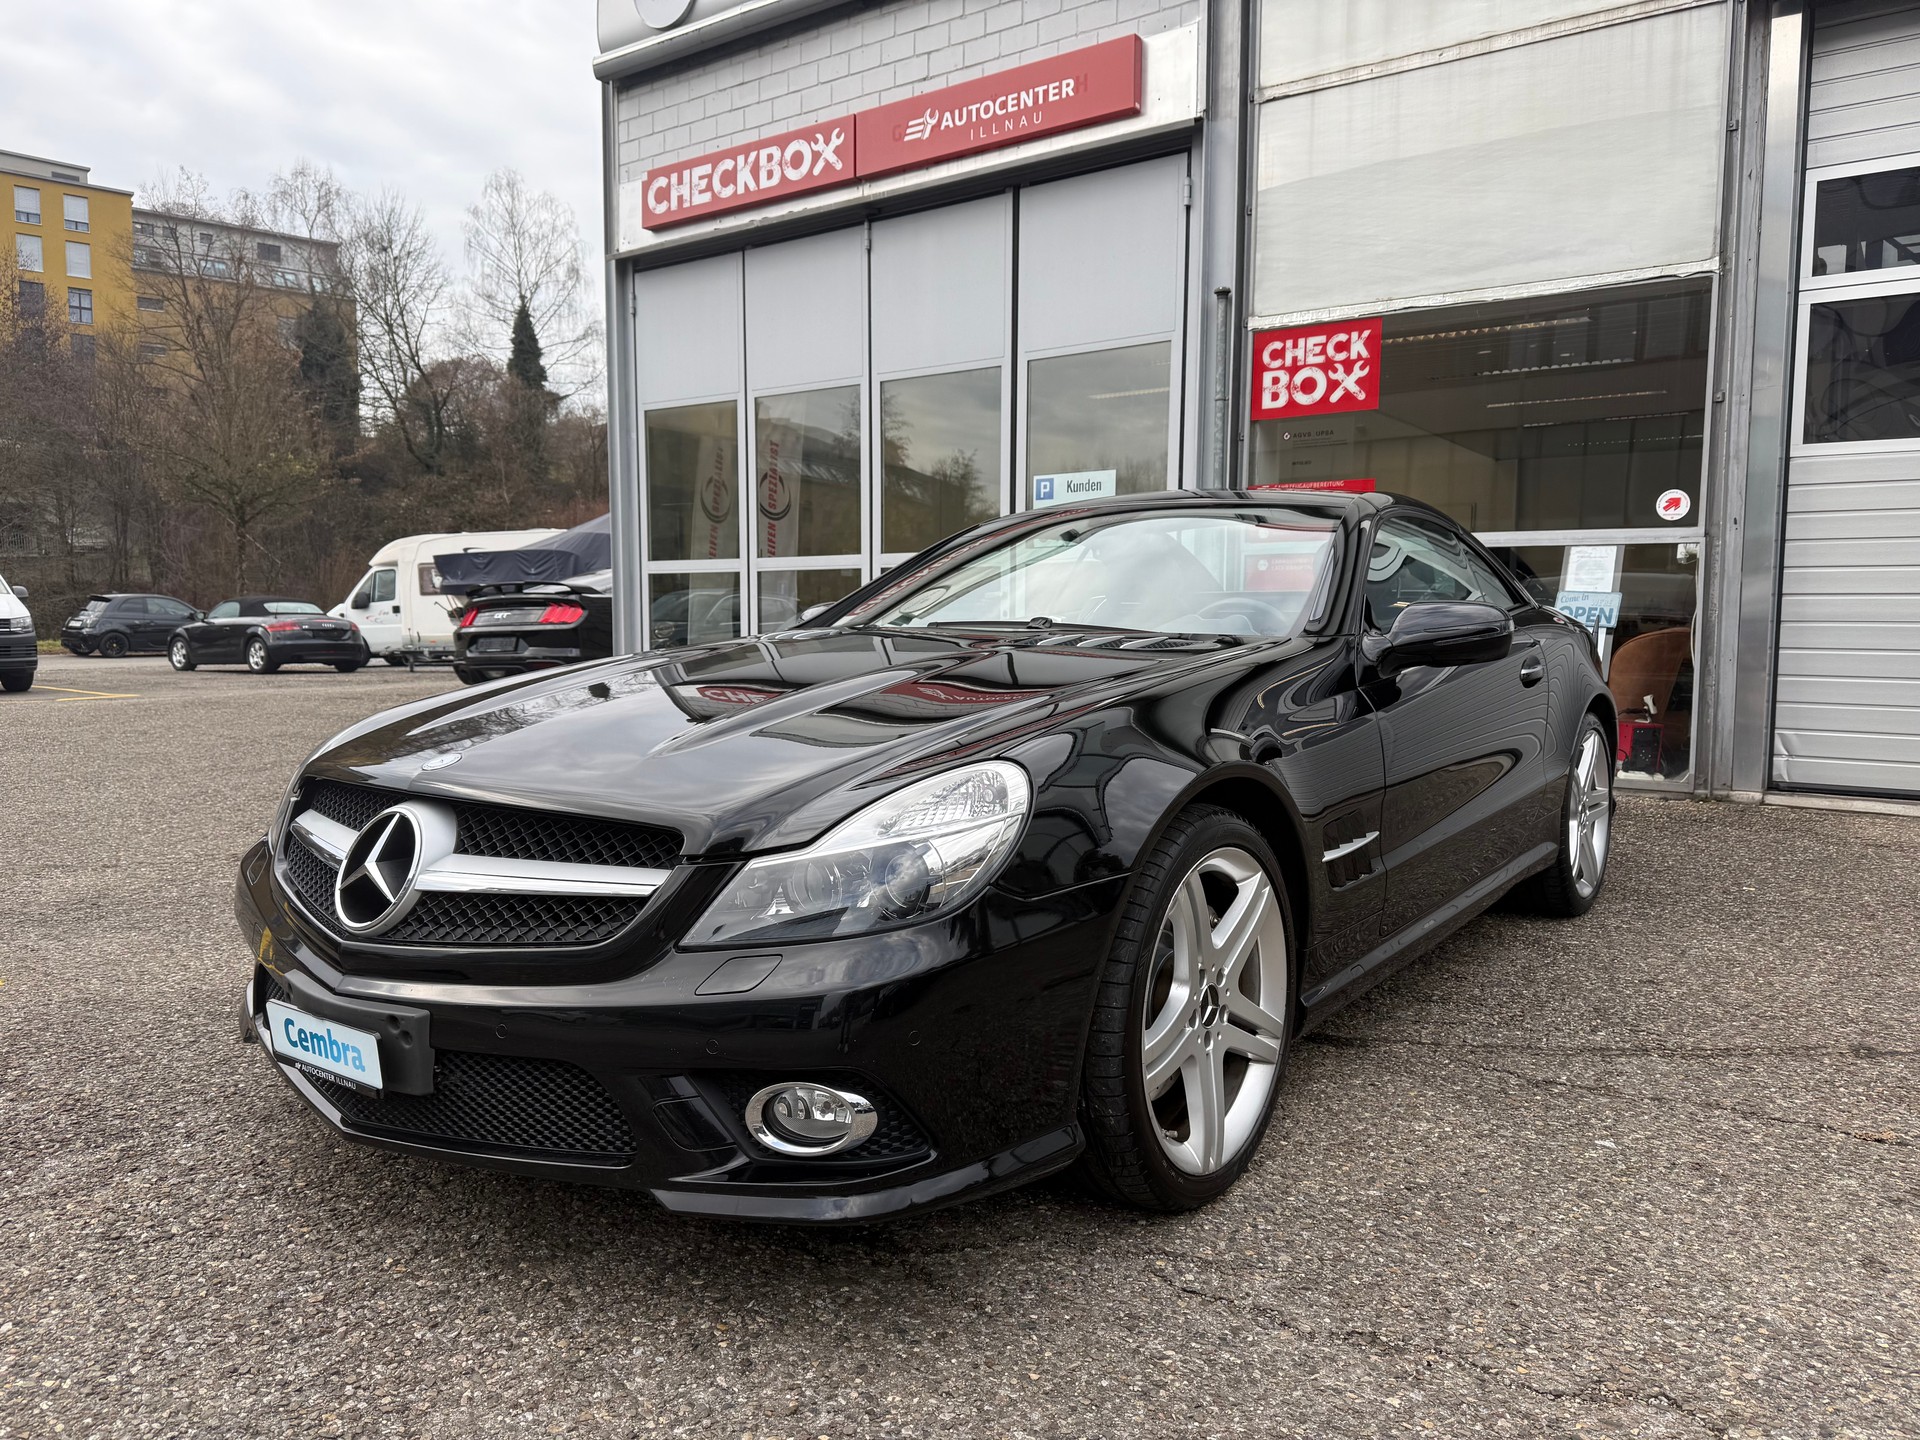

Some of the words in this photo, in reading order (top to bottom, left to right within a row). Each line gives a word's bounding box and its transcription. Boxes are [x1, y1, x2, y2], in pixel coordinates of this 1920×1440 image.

[940, 78, 1075, 130] AUTOCENTER
[970, 111, 1043, 141] ILLNAU
[647, 127, 845, 215] CHECKBOX
[1262, 329, 1372, 369] CHECK
[1261, 360, 1370, 410] BOX
[768, 439, 780, 511] SPEZIALIST
[1066, 478, 1102, 494] Kunden
[707, 523, 720, 559] EIFEN
[767, 521, 777, 558] EIFEN
[283, 1017, 366, 1073] Cembra
[301, 1062, 336, 1083] AUTOCENTER
[336, 1076, 357, 1090] ILLNAU
